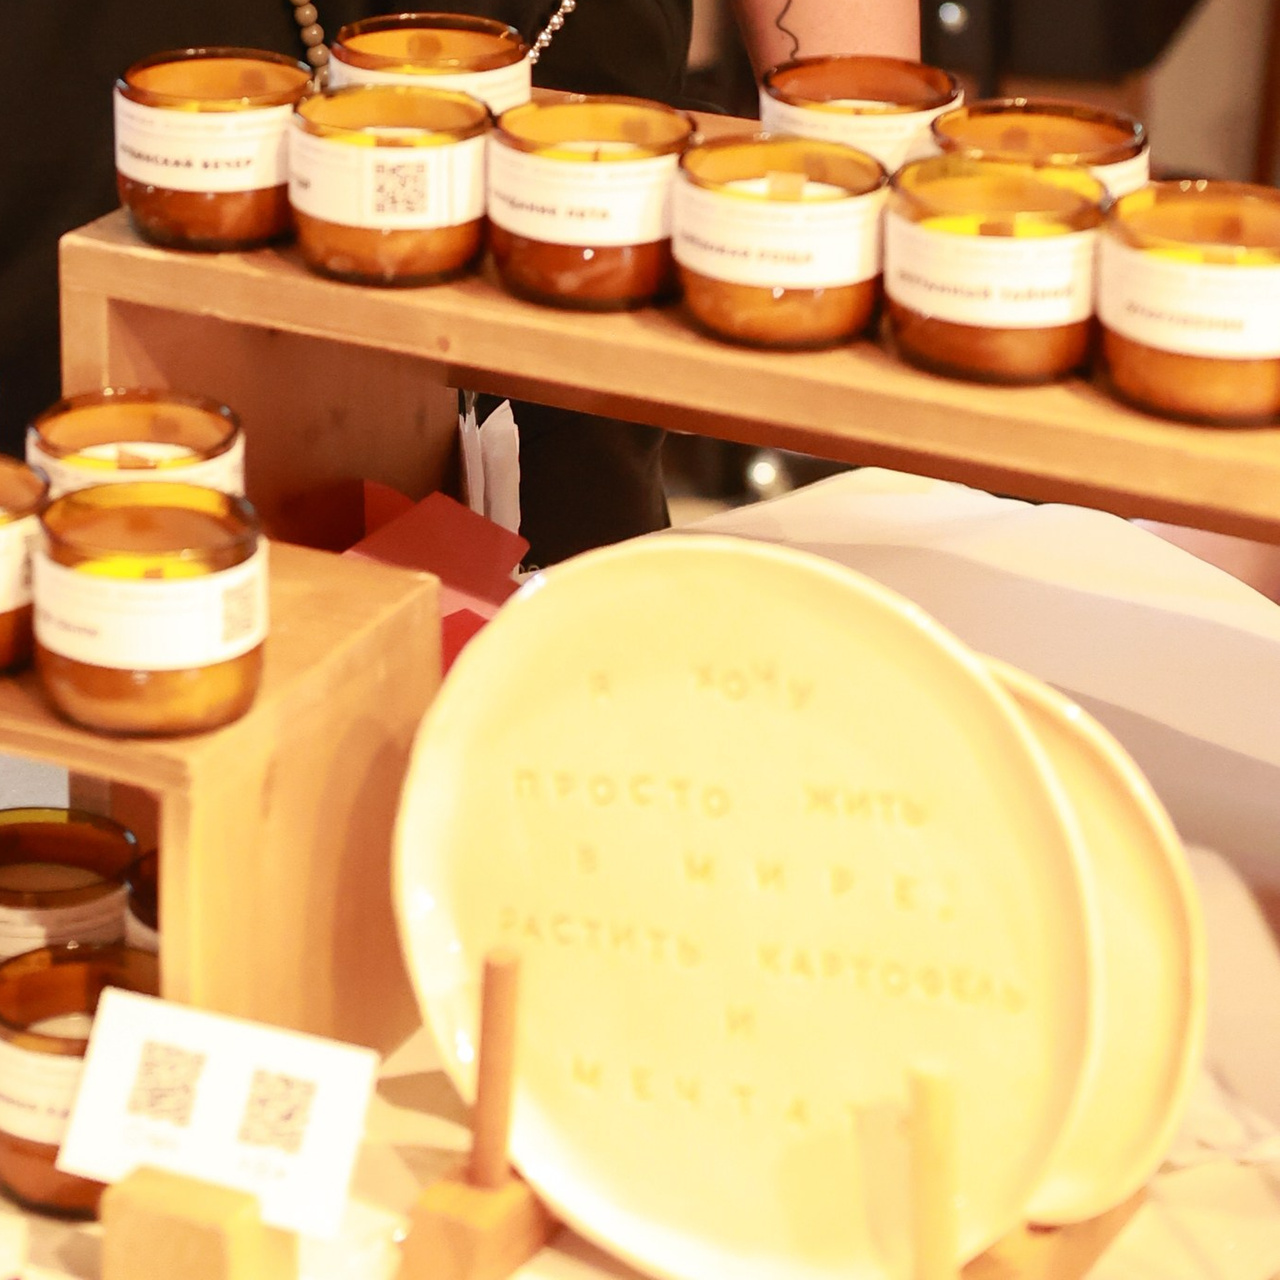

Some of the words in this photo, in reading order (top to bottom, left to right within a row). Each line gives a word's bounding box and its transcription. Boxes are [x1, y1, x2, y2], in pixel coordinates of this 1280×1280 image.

[690, 658, 818, 710] ХОЧУ
[513, 765, 732, 820] ПРОСТО
[801, 781, 928, 828] ЖИТЬ
[498, 906, 706, 969] РАСТИТЬ
[757, 941, 1027, 1015] КАРТОФЕЛЬ
